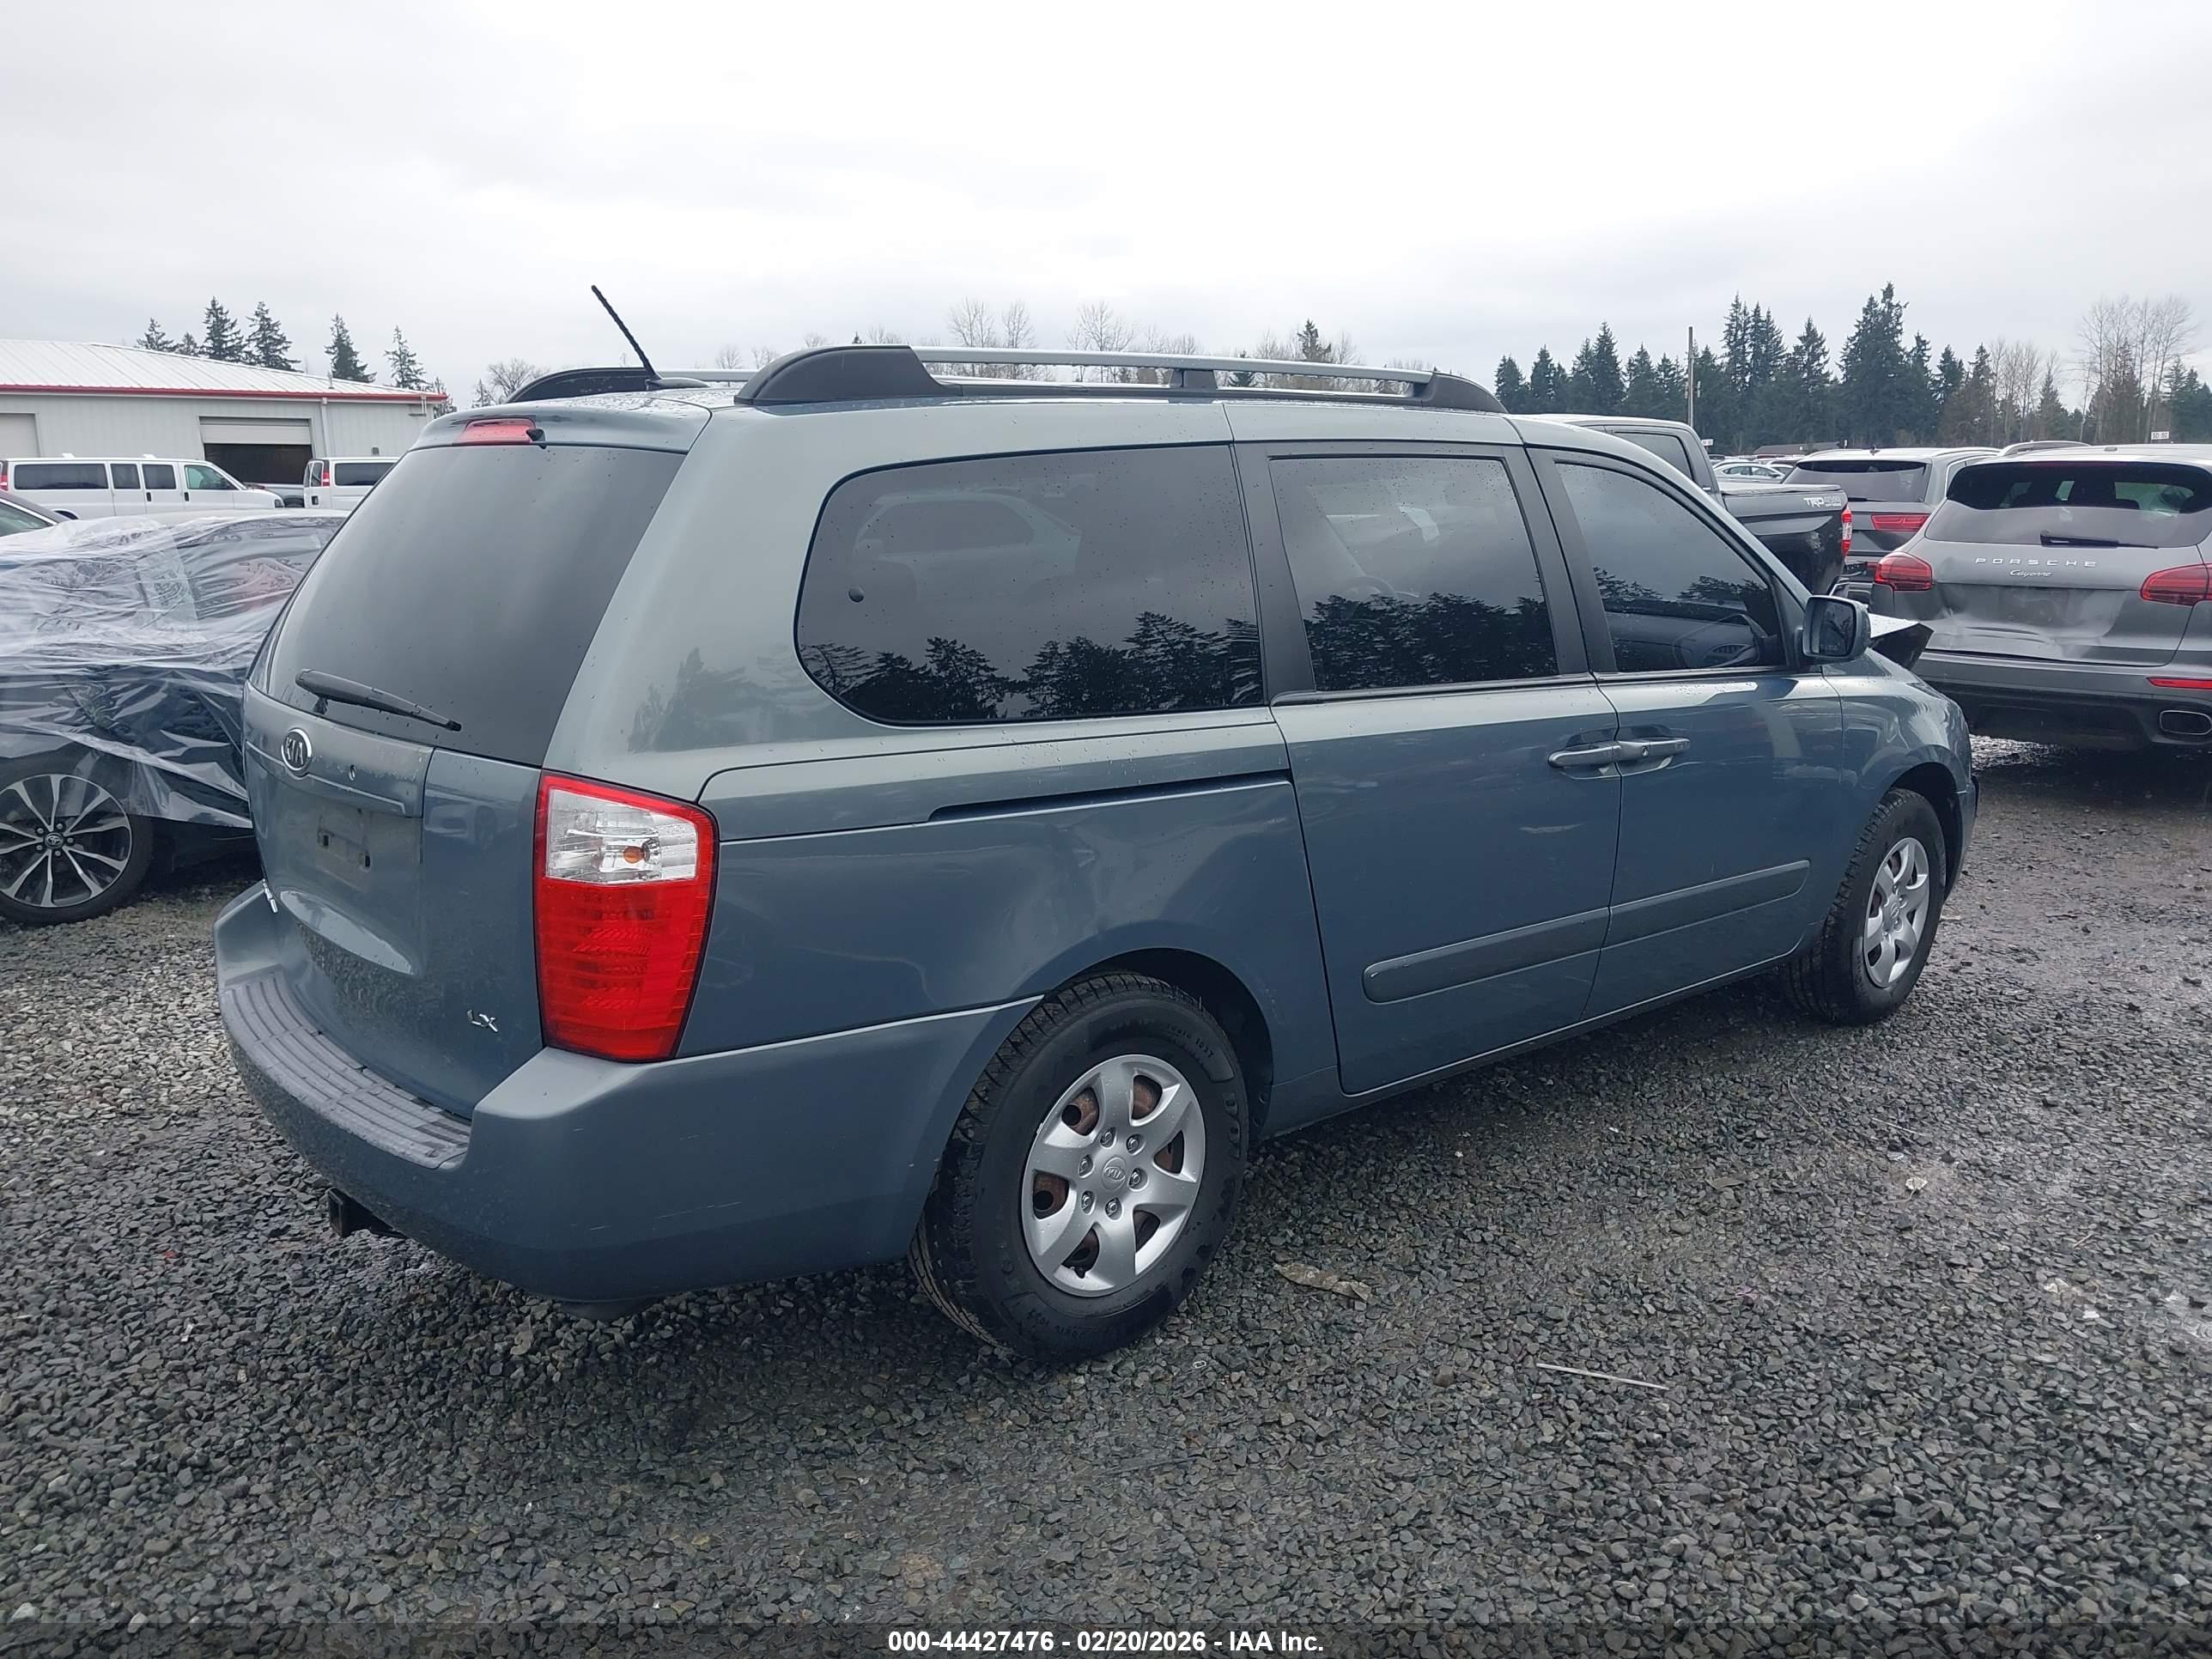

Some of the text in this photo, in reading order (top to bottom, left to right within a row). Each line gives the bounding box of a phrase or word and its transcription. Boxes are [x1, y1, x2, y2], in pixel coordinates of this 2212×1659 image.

[1803, 497, 1825, 507] TRD
[1975, 557, 2097, 568] PORSCHE
[2009, 569, 2052, 578] Cayenne
